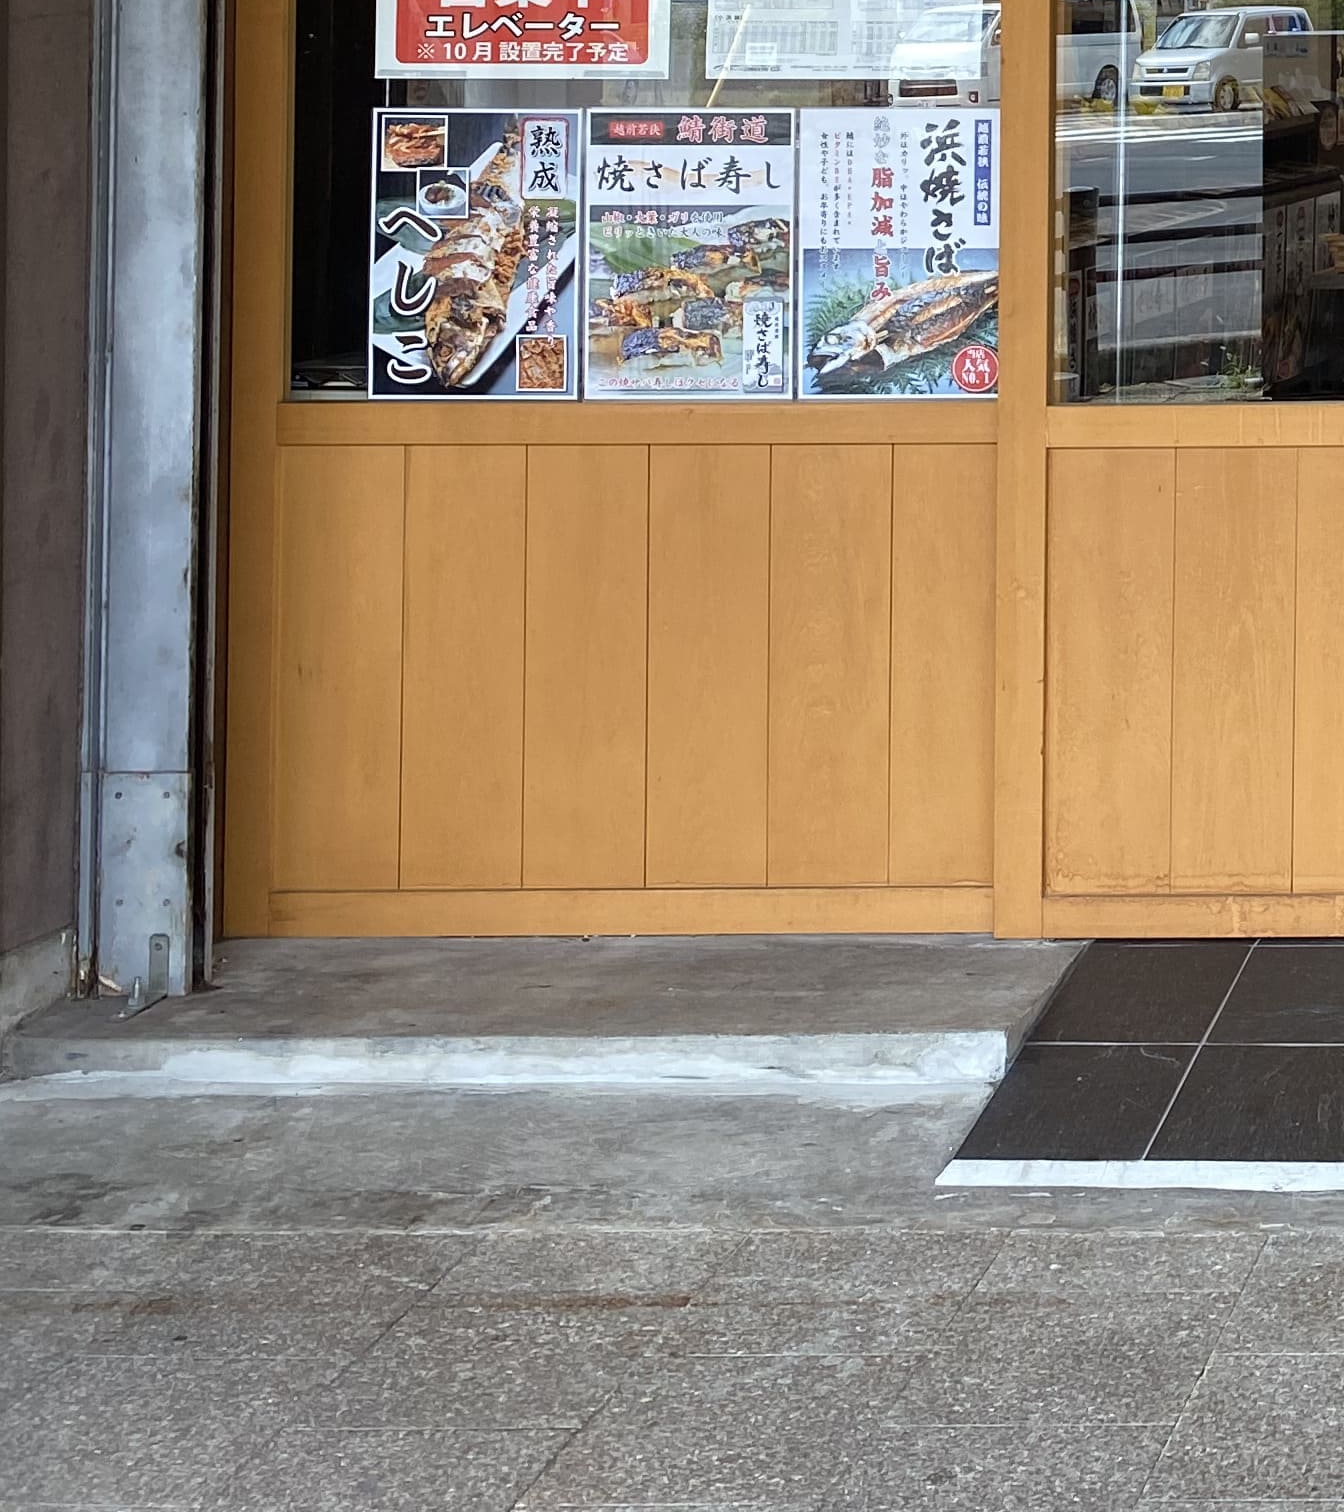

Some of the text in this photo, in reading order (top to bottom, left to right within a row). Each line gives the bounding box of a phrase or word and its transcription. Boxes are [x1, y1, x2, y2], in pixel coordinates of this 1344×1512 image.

[425, 12, 620, 40] エレベーター
[529, 125, 561, 192] 熟成
[613, 115, 769, 144] 越前若狭 鯖街道
[597, 155, 781, 195] 焼さば寿し
[920, 118, 967, 275] 浜焼さば
[380, 207, 442, 384] へしこ
[526, 206, 541, 332] 栄養豊富な健康食品
[753, 311, 773, 388] 焼さば寿し
[963, 359, 990, 372] 人気
